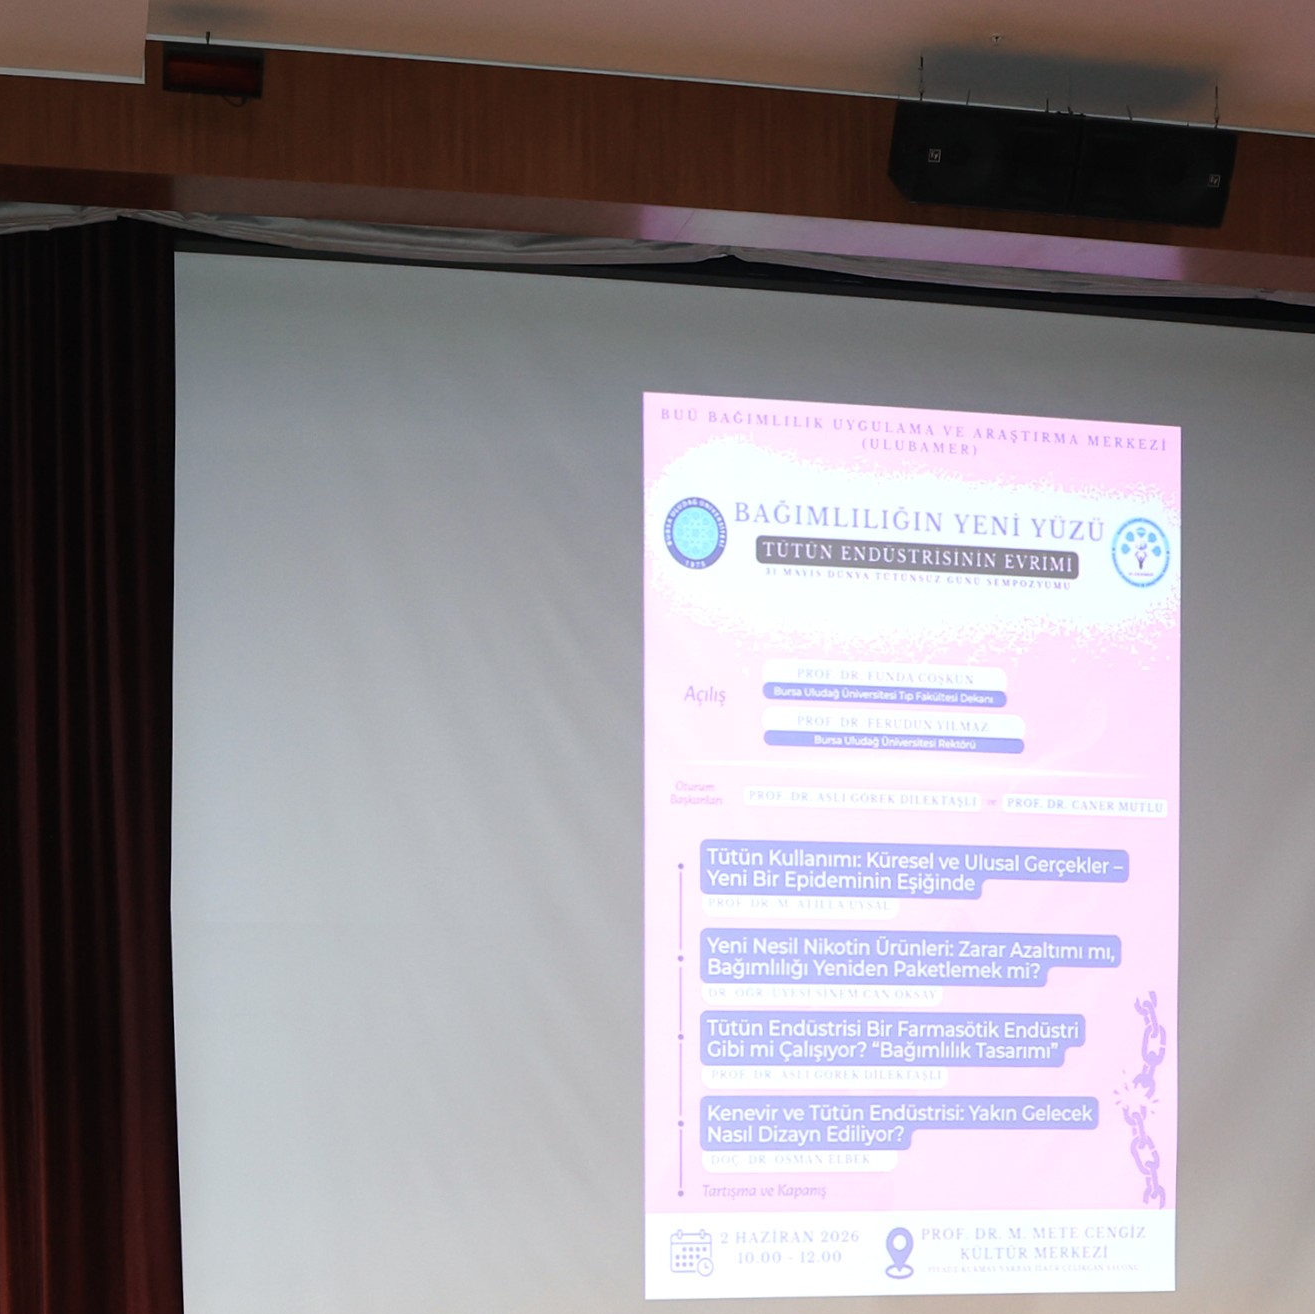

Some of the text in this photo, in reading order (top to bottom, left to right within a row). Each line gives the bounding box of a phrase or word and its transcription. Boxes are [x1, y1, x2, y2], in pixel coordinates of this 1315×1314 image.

[661, 407, 1167, 452] BUÜ BAĞIMLILIK UYGULAMA VE ARAŞTIRMA MERKEZİ
[861, 437, 978, 457] (ULUBAMER)
[734, 500, 1105, 542] BAĞIMLILIĞIN YENİ YÜZÜ
[761, 540, 1074, 573] TÜTÜN ENDÜSTRİSİNİN EVRİMİ
[867, 671, 914, 683] FUNDA
[917, 672, 974, 686] COŞKUN
[682, 685, 727, 707] Açılış
[773, 686, 994, 704] Bursa Uludağ Üniversitesi Tıp Fakültesi Dekanı
[867, 718, 933, 730] FERUDUN
[936, 720, 990, 733] YILMAZ
[814, 735, 977, 751] Bursa Uludağ Üniversitesi Rektörü
[817, 791, 846, 803] ASLI
[1071, 800, 1115, 812] CANER
[1118, 801, 1164, 814] MUTLU
[706, 847, 763, 866] Tütün
[769, 849, 862, 868] Kullanımı:
[866, 851, 934, 870] Küresel
[937, 857, 960, 870] ve
[964, 854, 1021, 872] Ulusal
[1024, 855, 1110, 878] Gerçekler
[706, 869, 976, 895] Yeni Bir Epideminin Eşiğinde
[706, 936, 1115, 963] Yeni Nesil Nikotin Ürünleri: Zarar Azaltımı mı,
[707, 957, 1041, 980] Bağımlılığı Yeniden Paketlemek mi?
[706, 1018, 1079, 1039] Tütün Endüstrisi Bir Farmasötik Endüstri
[707, 1040, 745, 1058] Gibi
[749, 1041, 775, 1058] mi
[779, 1041, 867, 1063] Çalışıyor?
[707, 1104, 1093, 1122] Kenevir ve Tütün Endüstrisi: Yakın Gelecek
[707, 1126, 905, 1147] Nasıl Dizayn Ediliyor?
[702, 1184, 828, 1201] Tartışma ve Kapanış
[720, 1229, 860, 1244] 2 HAZİRAN 2026
[920, 1224, 1146, 1240] PROF. DR. M. METE CENGİZ
[738, 1251, 782, 1264] 10.00
[800, 1250, 842, 1263] 12.00
[960, 1244, 1108, 1260] KÜLTÜR MERKEZİ
